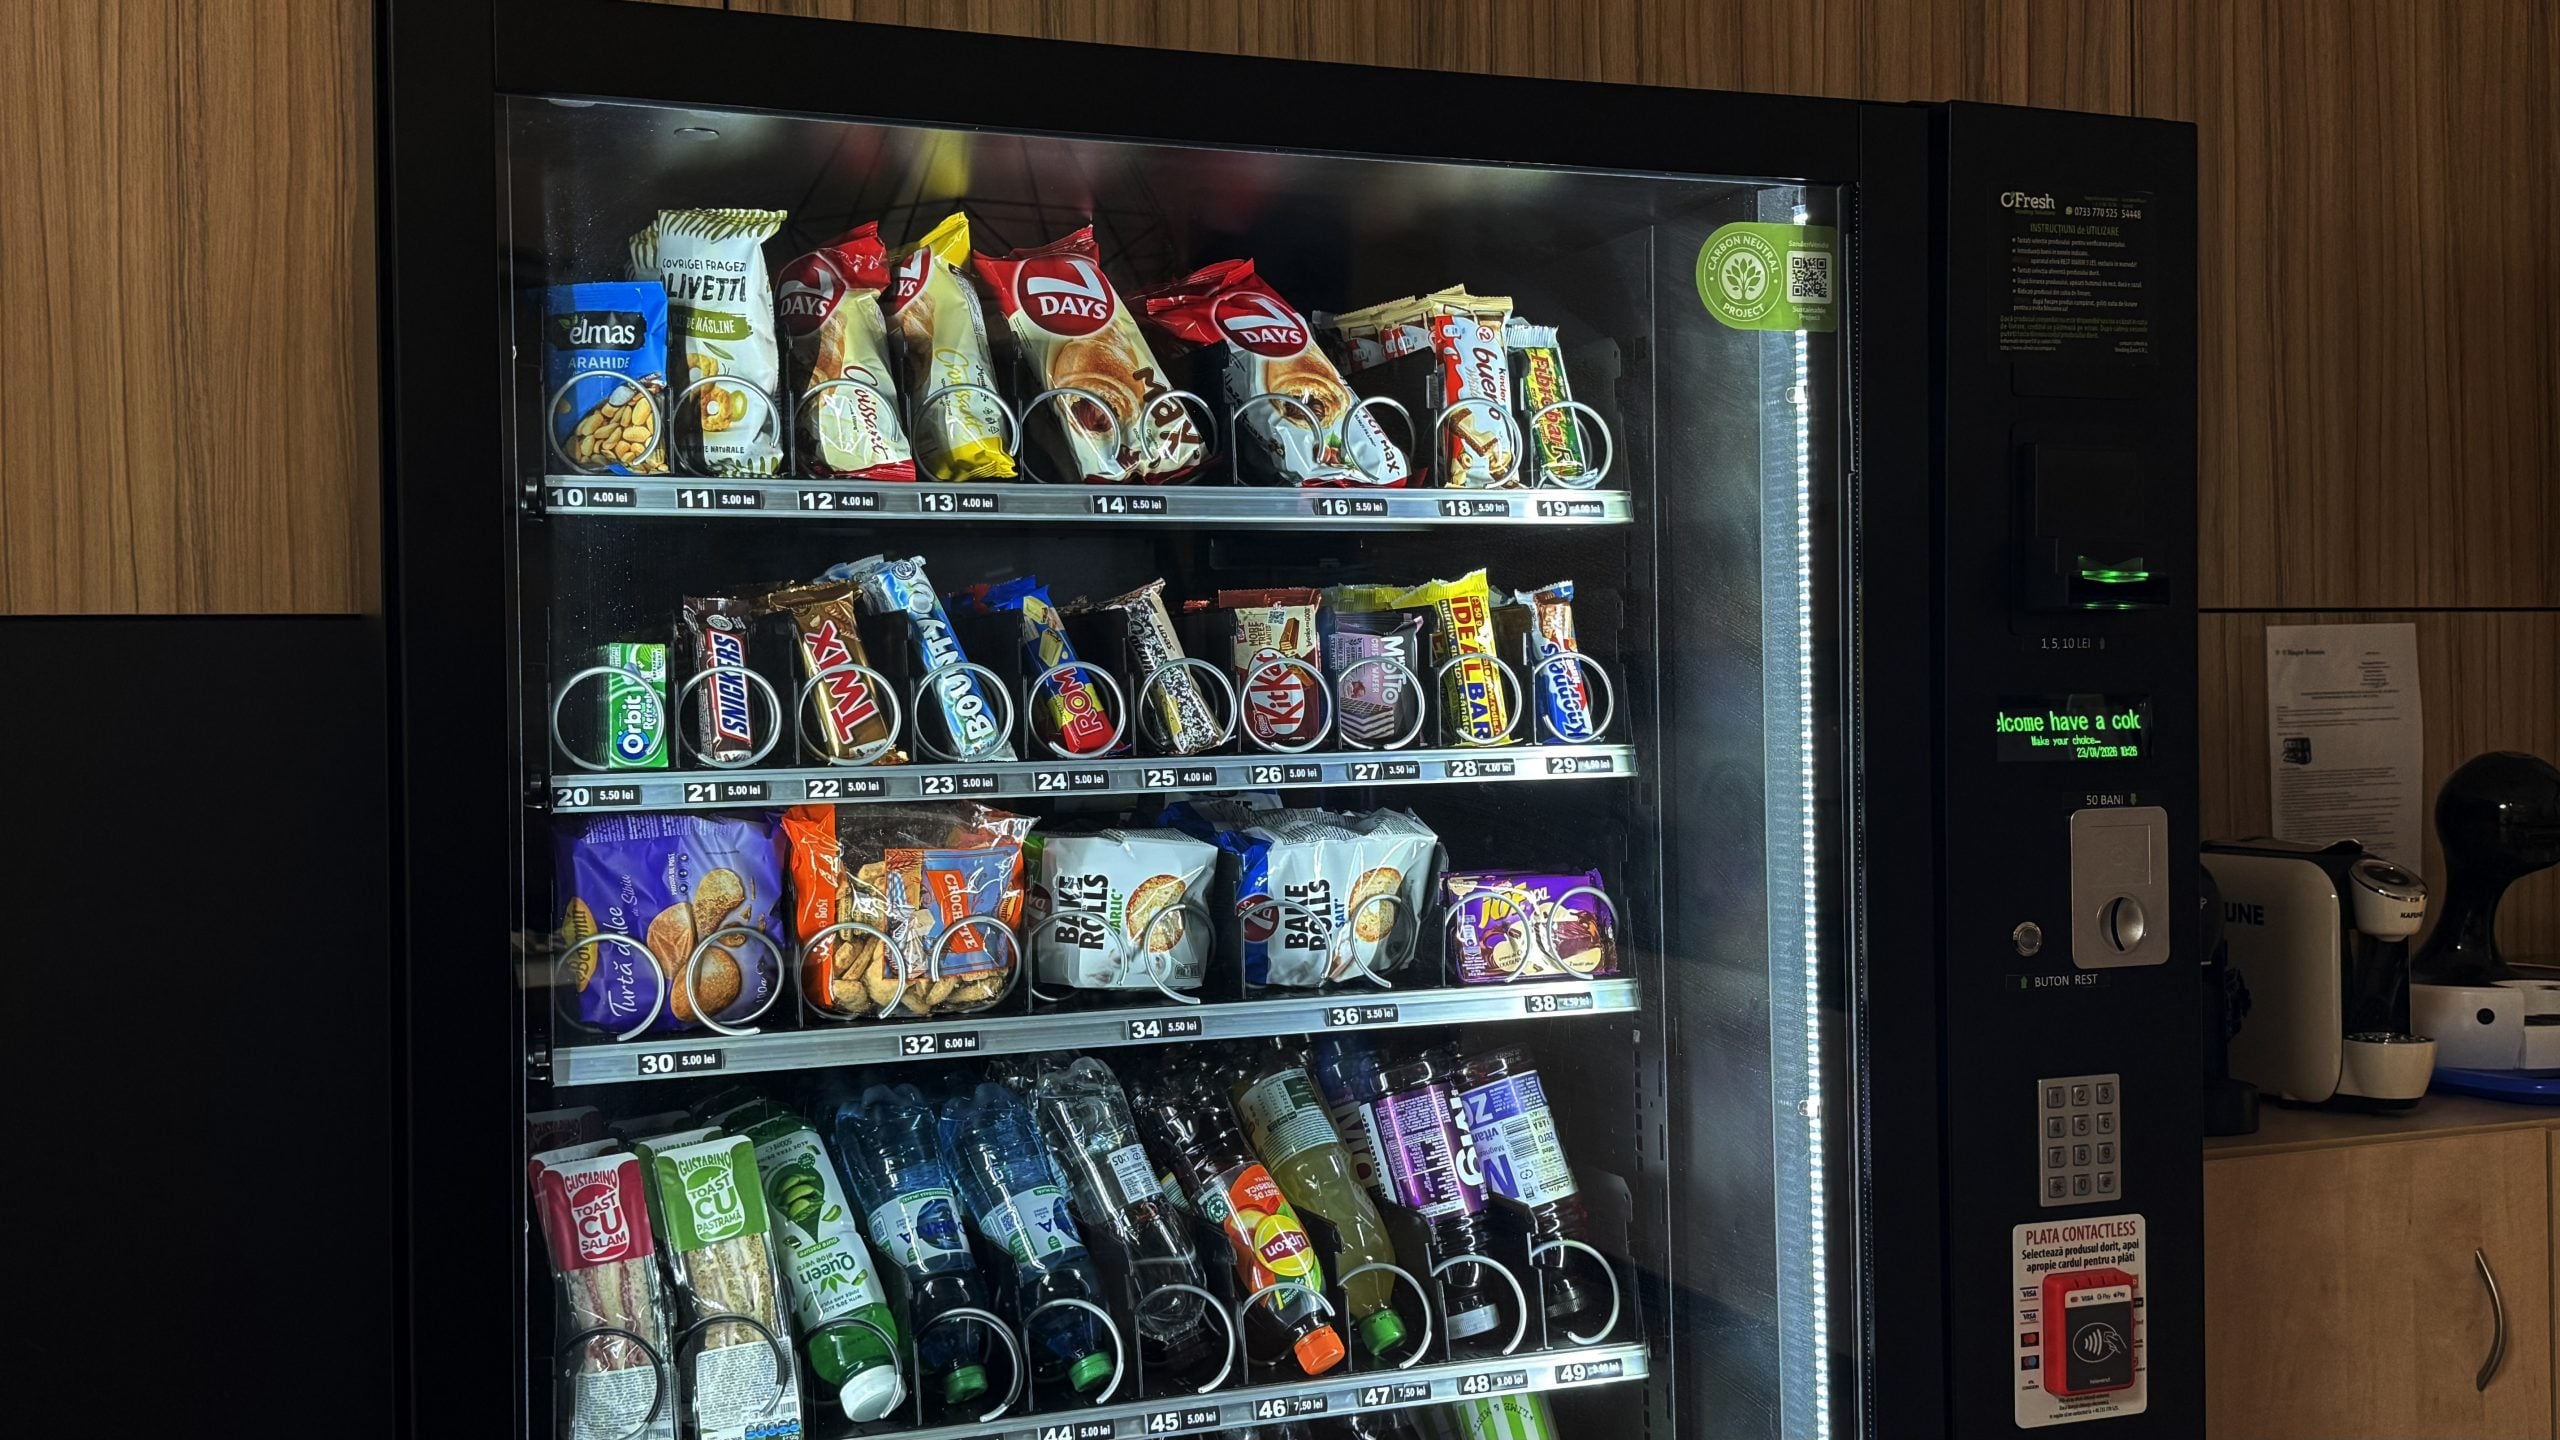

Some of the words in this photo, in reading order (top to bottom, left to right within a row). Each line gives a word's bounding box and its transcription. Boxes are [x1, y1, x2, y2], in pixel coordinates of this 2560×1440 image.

[2074, 206, 2091, 217] 0733
[2092, 207, 2105, 217] 770
[2105, 208, 2118, 218] 525
[2086, 225, 2120, 236] UTILIZARE
[1708, 235, 1741, 271] CARBON
[1743, 235, 1780, 274] NEUTRAL
[662, 258, 703, 270] COVRIGEI
[706, 260, 747, 272] FRAGEZI
[661, 273, 747, 302] LIVETTI
[780, 266, 834, 300] 7
[1026, 260, 1108, 303] 7
[780, 296, 830, 317] DAYS
[1038, 295, 1108, 320] DAYS
[1224, 299, 1299, 331] 7
[1722, 302, 1766, 318] PROJECT
[569, 318, 635, 345] elmas
[1240, 328, 1303, 345] DAYS
[568, 356, 630, 369] ARAHIDE
[1473, 347, 1501, 421] bueno
[710, 445, 745, 455] NATURALE
[552, 490, 583, 506] 10
[593, 493, 614, 503] 4.00
[616, 492, 628, 503] lei
[681, 491, 711, 508] 11
[722, 495, 743, 505] 5.00
[744, 495, 755, 505] lei
[803, 493, 833, 509] 12
[841, 497, 863, 506] 4.00
[865, 497, 873, 506] lei
[925, 494, 953, 511] 13
[963, 499, 984, 508] 4.00
[985, 499, 993, 508] lei
[1097, 497, 1125, 513] 14
[1133, 500, 1150, 509] 5.50
[1152, 500, 1162, 509] lei
[1322, 499, 1348, 515] 16
[1356, 503, 1372, 511] 5.50
[1373, 502, 1383, 512] lei
[1446, 501, 1472, 516] 18
[1248, 621, 1258, 647] MORE
[2041, 638, 2049, 650] 1,
[2051, 638, 2060, 650] 5,
[2063, 638, 2075, 648] 10
[2077, 638, 2091, 648] LEI
[1451, 596, 1481, 676] IDEAL
[1467, 681, 1491, 738] BAR
[713, 632, 749, 737] SNICKERS
[803, 619, 880, 745] TWIX
[915, 616, 994, 741] BOUNTY
[1250, 652, 1302, 724] KitKat
[1052, 666, 1104, 736] ROM
[622, 695, 644, 754] Orbit
[2049, 710, 2089, 731] have
[2095, 714, 2106, 730] a
[1148, 770, 1175, 786] 25
[1183, 773, 1201, 782] 4.00
[1202, 772, 1212, 781] lei
[1255, 766, 1282, 783] 26
[1289, 769, 1306, 778] 5.00
[1307, 768, 1317, 777] lei
[1355, 763, 1380, 779] 27
[809, 781, 840, 798] 22
[848, 782, 870, 791] 5.00
[871, 781, 879, 791] lei
[925, 776, 954, 793] 23
[962, 778, 981, 788] 5.00
[983, 777, 993, 787] lei
[1038, 773, 1067, 790] 24
[1074, 775, 1092, 784] 5.00
[1093, 774, 1104, 784] lei
[556, 788, 590, 806] 20
[599, 791, 621, 800] 5.50
[622, 790, 634, 799] lei
[688, 784, 717, 802] 21
[728, 786, 748, 795] 5.00
[749, 785, 761, 795] lei
[2086, 795, 2098, 805] 50
[2100, 794, 2124, 805] BANI
[1055, 875, 1083, 945] BAKE
[1079, 873, 1109, 950] ROLLS
[1284, 884, 1309, 950] BAKE
[1308, 878, 1333, 951] ROLLS
[603, 906, 632, 956] dlce
[608, 962, 638, 1017] Turtă
[2035, 975, 2070, 988] BUTON
[2074, 974, 2098, 985] REST
[1332, 1008, 1359, 1025] 36
[1366, 1010, 1383, 1019] 5.50
[1384, 1008, 1394, 1018] lei
[1131, 1021, 1160, 1038] 34
[1168, 1023, 1185, 1032] 5.50
[1186, 1021, 1197, 1031] lei
[905, 1036, 935, 1054] 32
[945, 1038, 963, 1049] 6.00
[965, 1037, 976, 1048] lei
[641, 1055, 674, 1073] 30
[682, 1056, 702, 1066] 5.00
[704, 1054, 716, 1064] lei
[678, 1151, 732, 1176] GUSTARINO
[564, 1169, 617, 1193] GUSTARINO
[688, 1173, 730, 1198] TOAST
[574, 1193, 616, 1217] TOAST
[694, 1186, 738, 1219] CU
[578, 1206, 623, 1239] CU
[696, 1208, 743, 1232] PASTRAMĂ
[581, 1231, 627, 1251] SALAM
[2025, 1227, 2060, 1246] PLATA
[2062, 1220, 2136, 1242] CONTACTLESS
[819, 1252, 839, 1266] aloe
[2022, 1245, 2064, 1260] Selectează
[2065, 1243, 2099, 1259] produsul
[2100, 1241, 2122, 1254] dorit,
[2122, 1239, 2139, 1253] apoi
[796, 1257, 818, 1271] vera
[800, 1251, 856, 1286] Queen
[2026, 1260, 2057, 1273] apropie
[2058, 1257, 2081, 1269] cardul
[2083, 1255, 2109, 1269] pentru
[2022, 1290, 2037, 1298] VISA
[2022, 1312, 2037, 1320] VISA
[1463, 1375, 1490, 1393] 48
[1365, 1387, 1391, 1405] 47
[1398, 1387, 1415, 1398] 7.50
[1416, 1385, 1426, 1396] lei
[1258, 1400, 1287, 1418] 46
[1294, 1400, 1311, 1411] 7.50
[1313, 1398, 1323, 1409] lei
[1150, 1413, 1179, 1432] 45
[1187, 1413, 1205, 1424] 5.00
[1205, 1411, 1216, 1422] lei
[1043, 1425, 1073, 1440] 44
[1080, 1426, 1099, 1437] 5.00
[1100, 1424, 1111, 1435] lei
